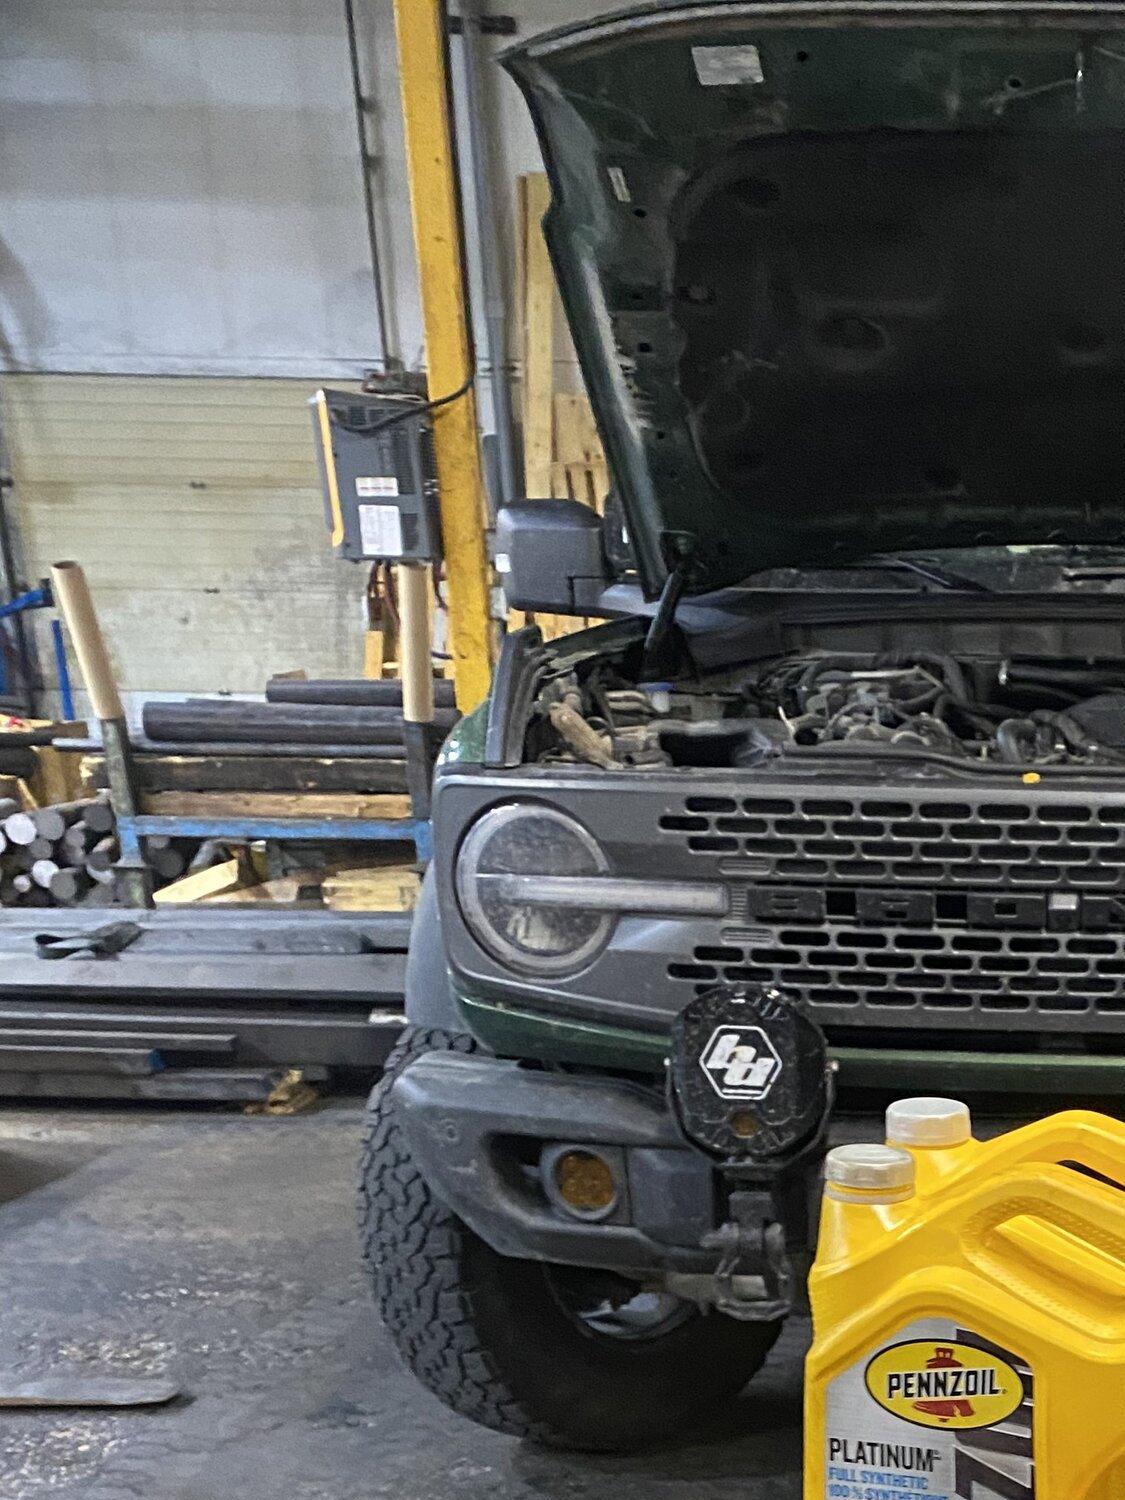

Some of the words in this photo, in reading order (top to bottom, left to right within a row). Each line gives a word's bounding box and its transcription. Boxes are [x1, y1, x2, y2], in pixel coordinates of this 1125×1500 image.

[888, 1369, 1000, 1398] PENNZOIL
[828, 1467, 857, 1483] FULL
[861, 1470, 928, 1490] SYNTHETIC
